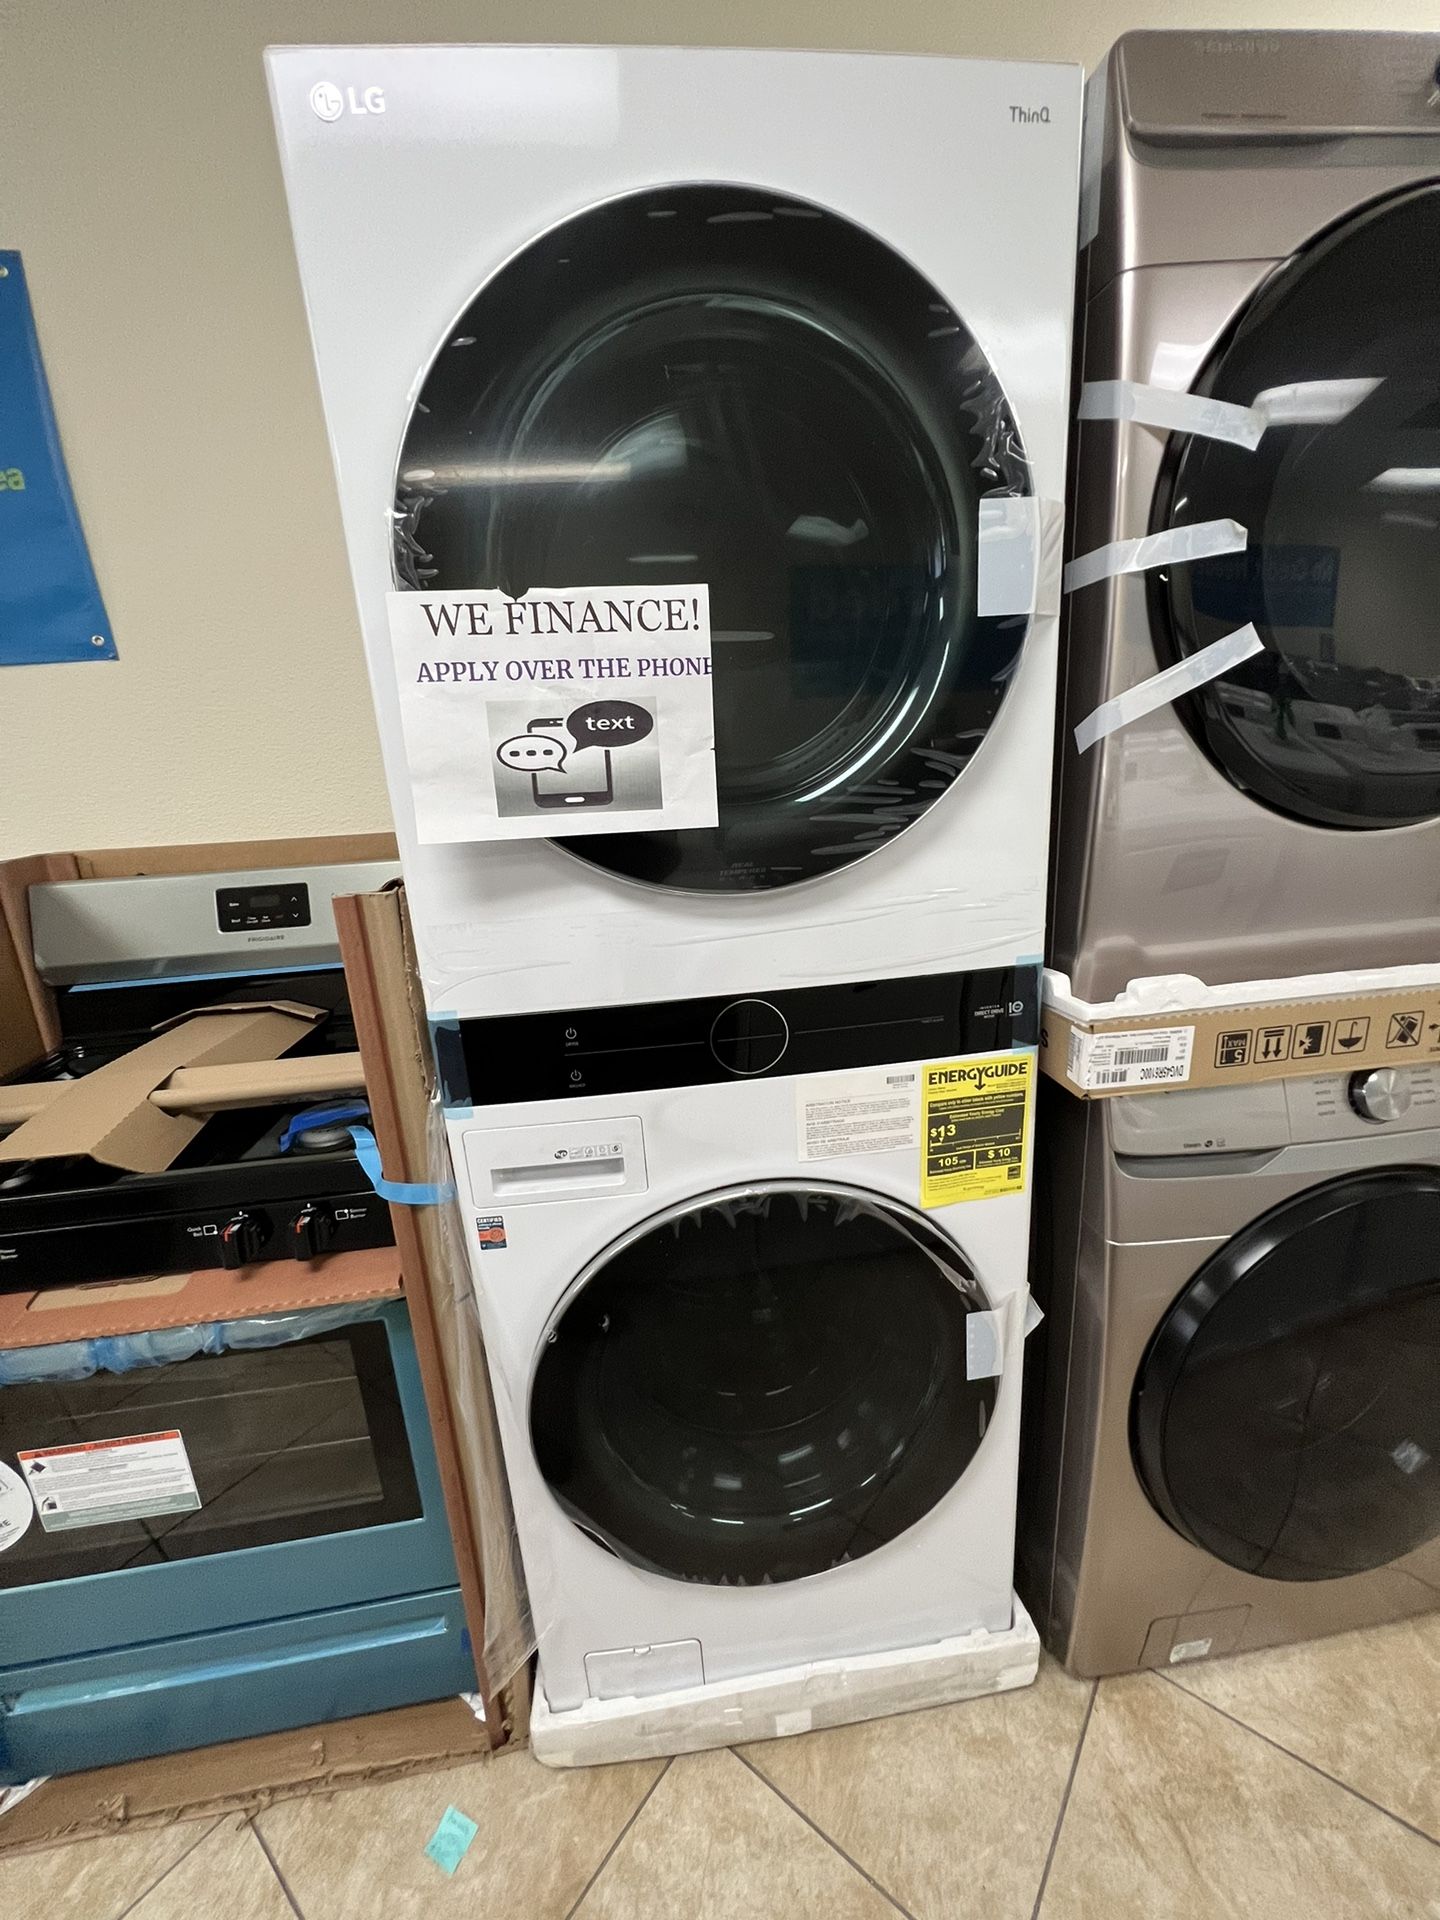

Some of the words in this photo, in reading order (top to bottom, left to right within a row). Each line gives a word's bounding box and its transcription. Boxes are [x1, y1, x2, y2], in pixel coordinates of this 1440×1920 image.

[347, 86, 386, 114] LG
[1009, 106, 1051, 123] ThinQ
[420, 602, 493, 636] WE
[503, 598, 700, 635] FINANCE!
[416, 661, 500, 683] APPLY
[505, 659, 574, 681] OVER
[578, 657, 632, 679] THE
[585, 715, 635, 731] text
[1228, 1039, 1246, 1048] MAX
[1234, 1049, 1243, 1063] 5
[928, 1062, 1028, 1086] ENERGYGUIDE
[938, 1156, 959, 1167] 105
